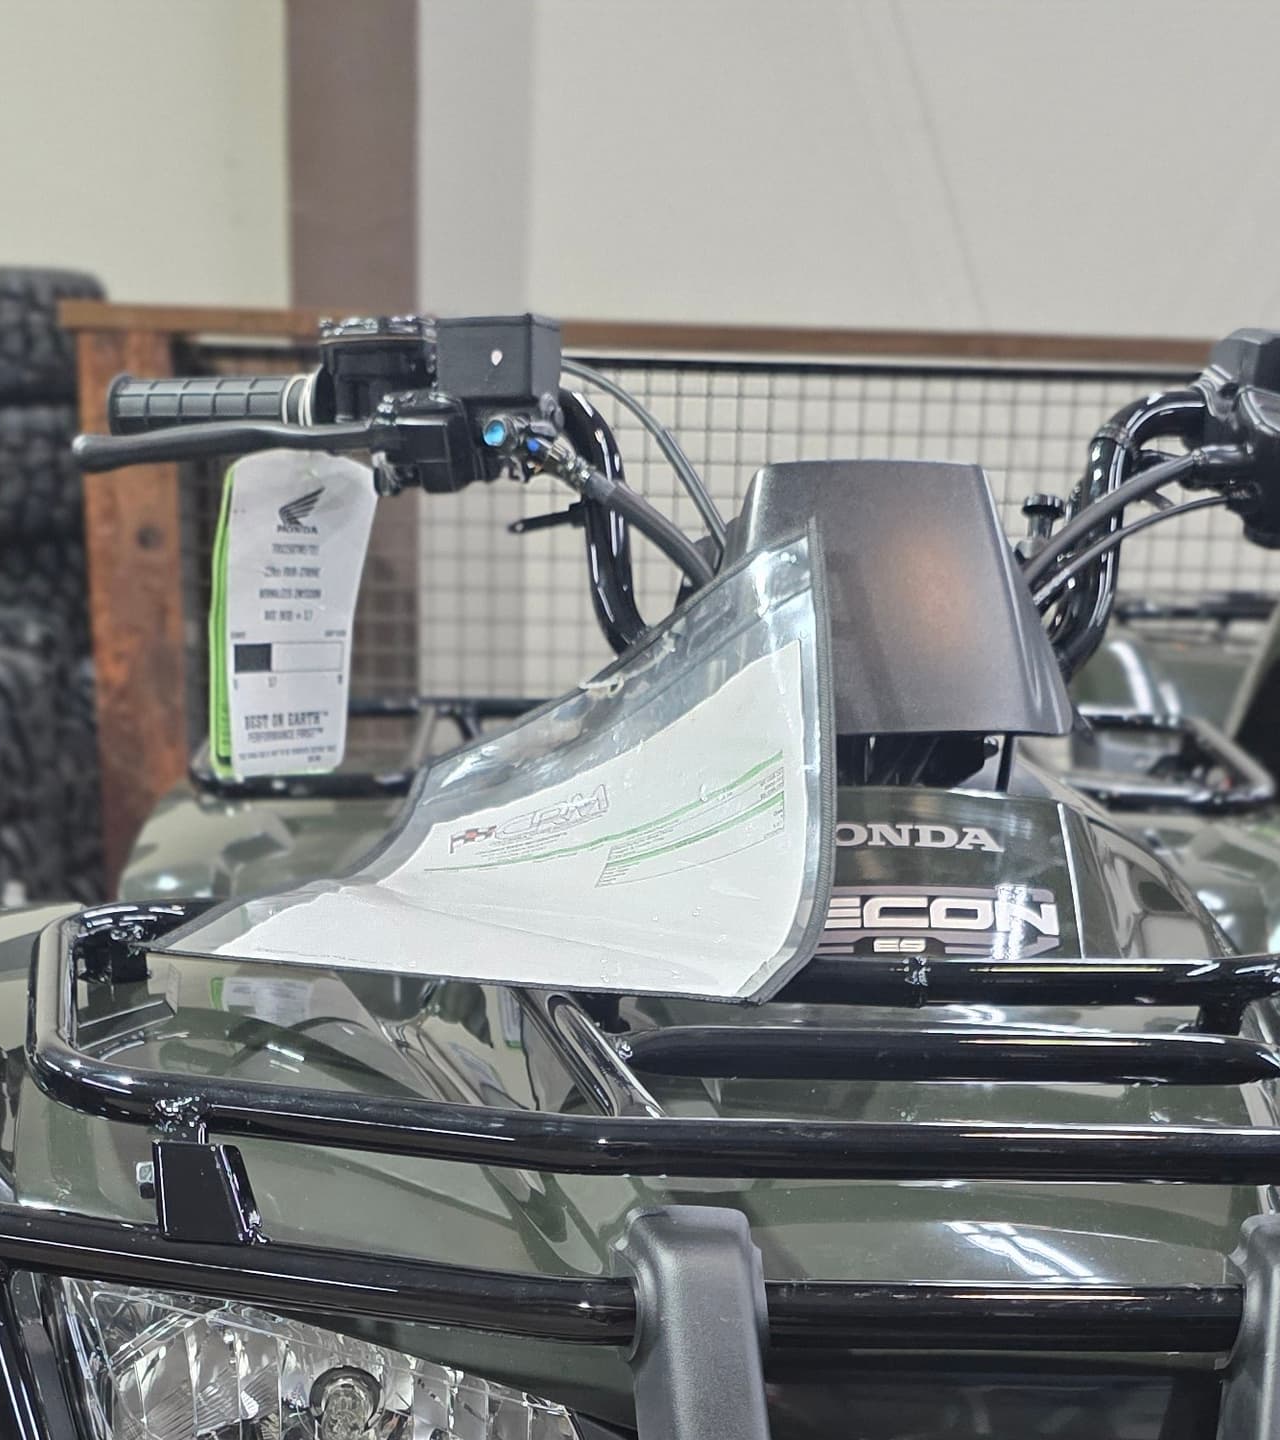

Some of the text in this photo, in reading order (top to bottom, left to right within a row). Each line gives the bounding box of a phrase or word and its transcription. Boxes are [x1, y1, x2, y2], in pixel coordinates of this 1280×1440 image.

[836, 822, 1006, 853] ONDA
[825, 895, 1061, 937] ECON
[872, 937, 926, 953] ES
